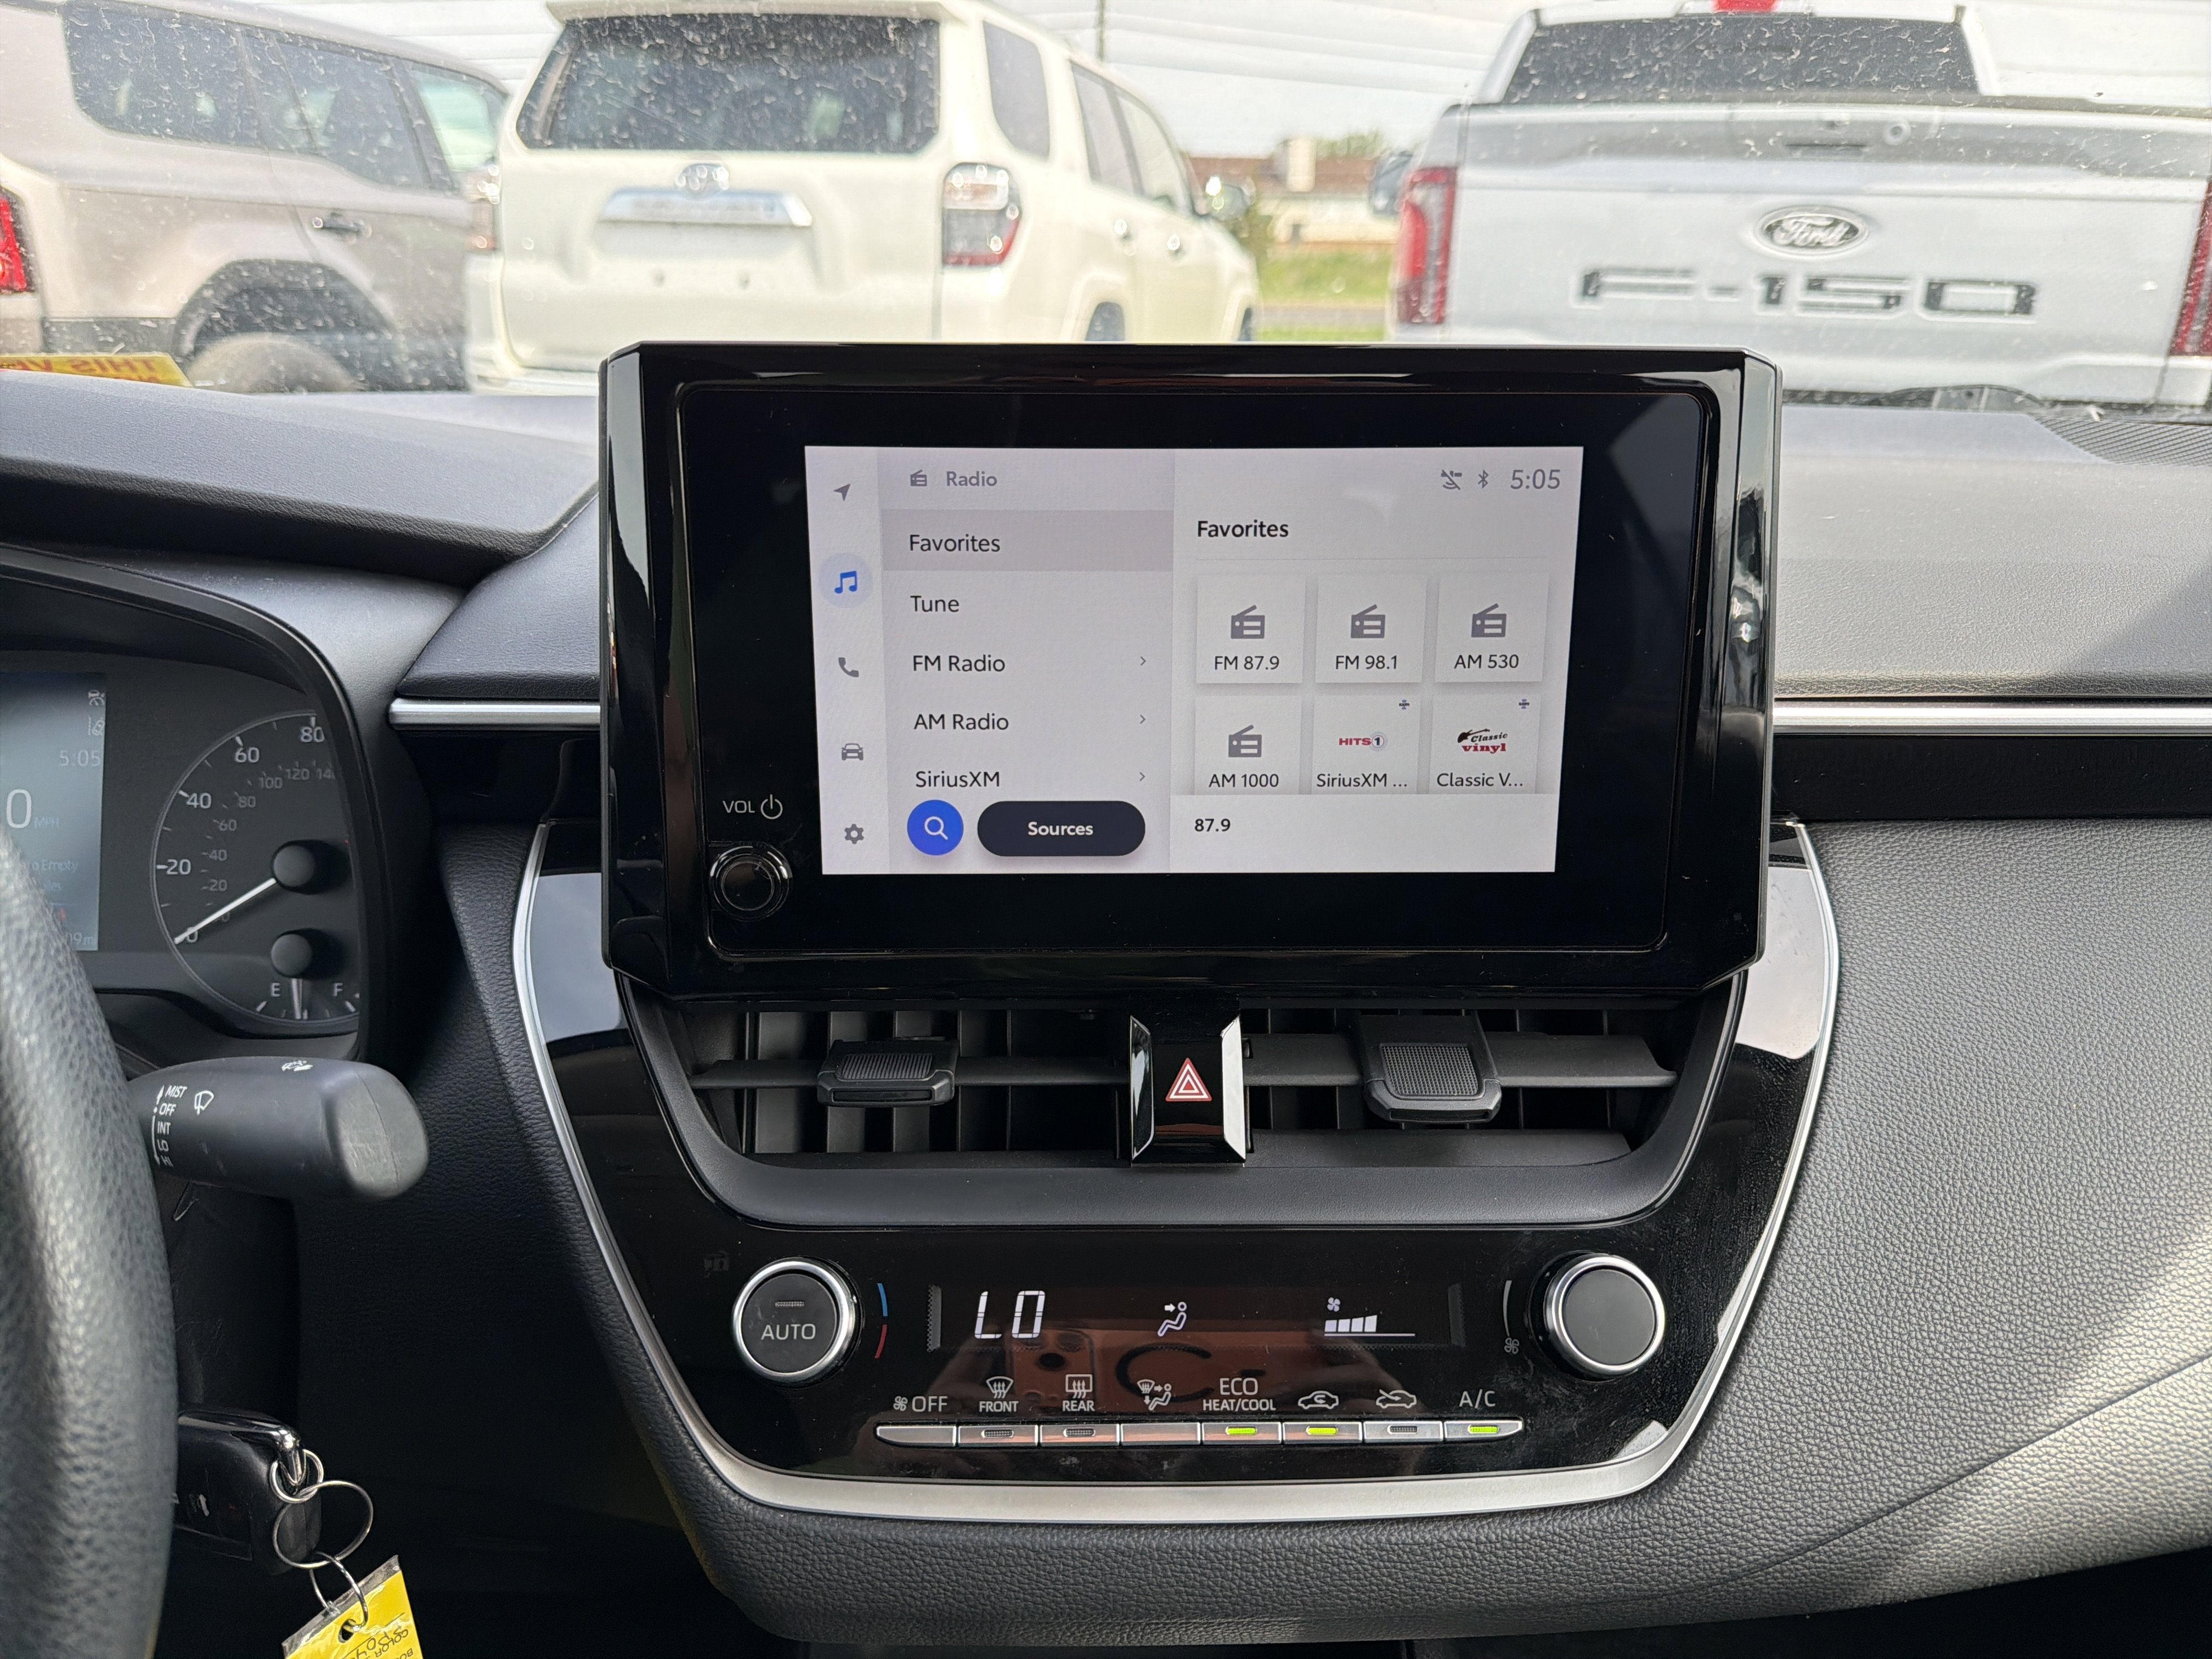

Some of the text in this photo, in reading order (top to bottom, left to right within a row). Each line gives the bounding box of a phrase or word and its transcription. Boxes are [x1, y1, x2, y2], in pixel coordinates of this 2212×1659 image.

[1772, 217, 1861, 248] Ford
[1579, 264, 2040, 316] F-150
[946, 471, 997, 487] Radio
[1510, 469, 1560, 490] 5:05
[1198, 519, 1289, 538] Favorites
[910, 533, 1000, 552] Favorites
[910, 595, 960, 613] Tune
[913, 654, 1006, 672] FM Radio
[1215, 656, 1279, 670] FM 87.9
[1335, 655, 1397, 670] FM 98.1
[1454, 654, 1519, 669] AM 530
[913, 713, 1009, 730] AM Radio
[300, 726, 325, 742] 80
[1338, 737, 1372, 746] HITS
[1470, 732, 1508, 744] Classic
[235, 747, 259, 763] 60
[1462, 743, 1506, 754] vinyl
[59, 750, 101, 766] 5:05
[285, 768, 311, 780] 120
[315, 768, 335, 780] 14
[916, 770, 1000, 788] SiriusXM
[1209, 774, 1279, 788] AM 1000
[1317, 773, 1387, 787] SiriusXM
[1437, 772, 1494, 787] Classic
[258, 776, 283, 789] 100
[6, 789, 32, 828] 0
[185, 793, 211, 809] 40
[238, 795, 256, 808] 80
[722, 800, 755, 814] VOL
[218, 819, 238, 832] 60
[1028, 821, 1093, 836] Sources
[1194, 818, 1231, 832] 87.9
[209, 849, 228, 861] 40
[166, 859, 191, 875] 20
[209, 879, 228, 891] 20
[271, 983, 281, 997] E
[334, 983, 342, 996] F
[165, 1085, 188, 1098] MIST
[159, 1103, 177, 1116] OFF
[157, 1121, 171, 1135] INT
[761, 1323, 816, 1340] AUTO
[1220, 1378, 1259, 1396] ECO
[912, 1396, 948, 1412] OFF
[977, 1399, 1020, 1414] FRONT
[1061, 1398, 1096, 1413] REAR
[1201, 1398, 1278, 1413] HEAT/COOL
[1459, 1389, 1496, 1409] A/C
